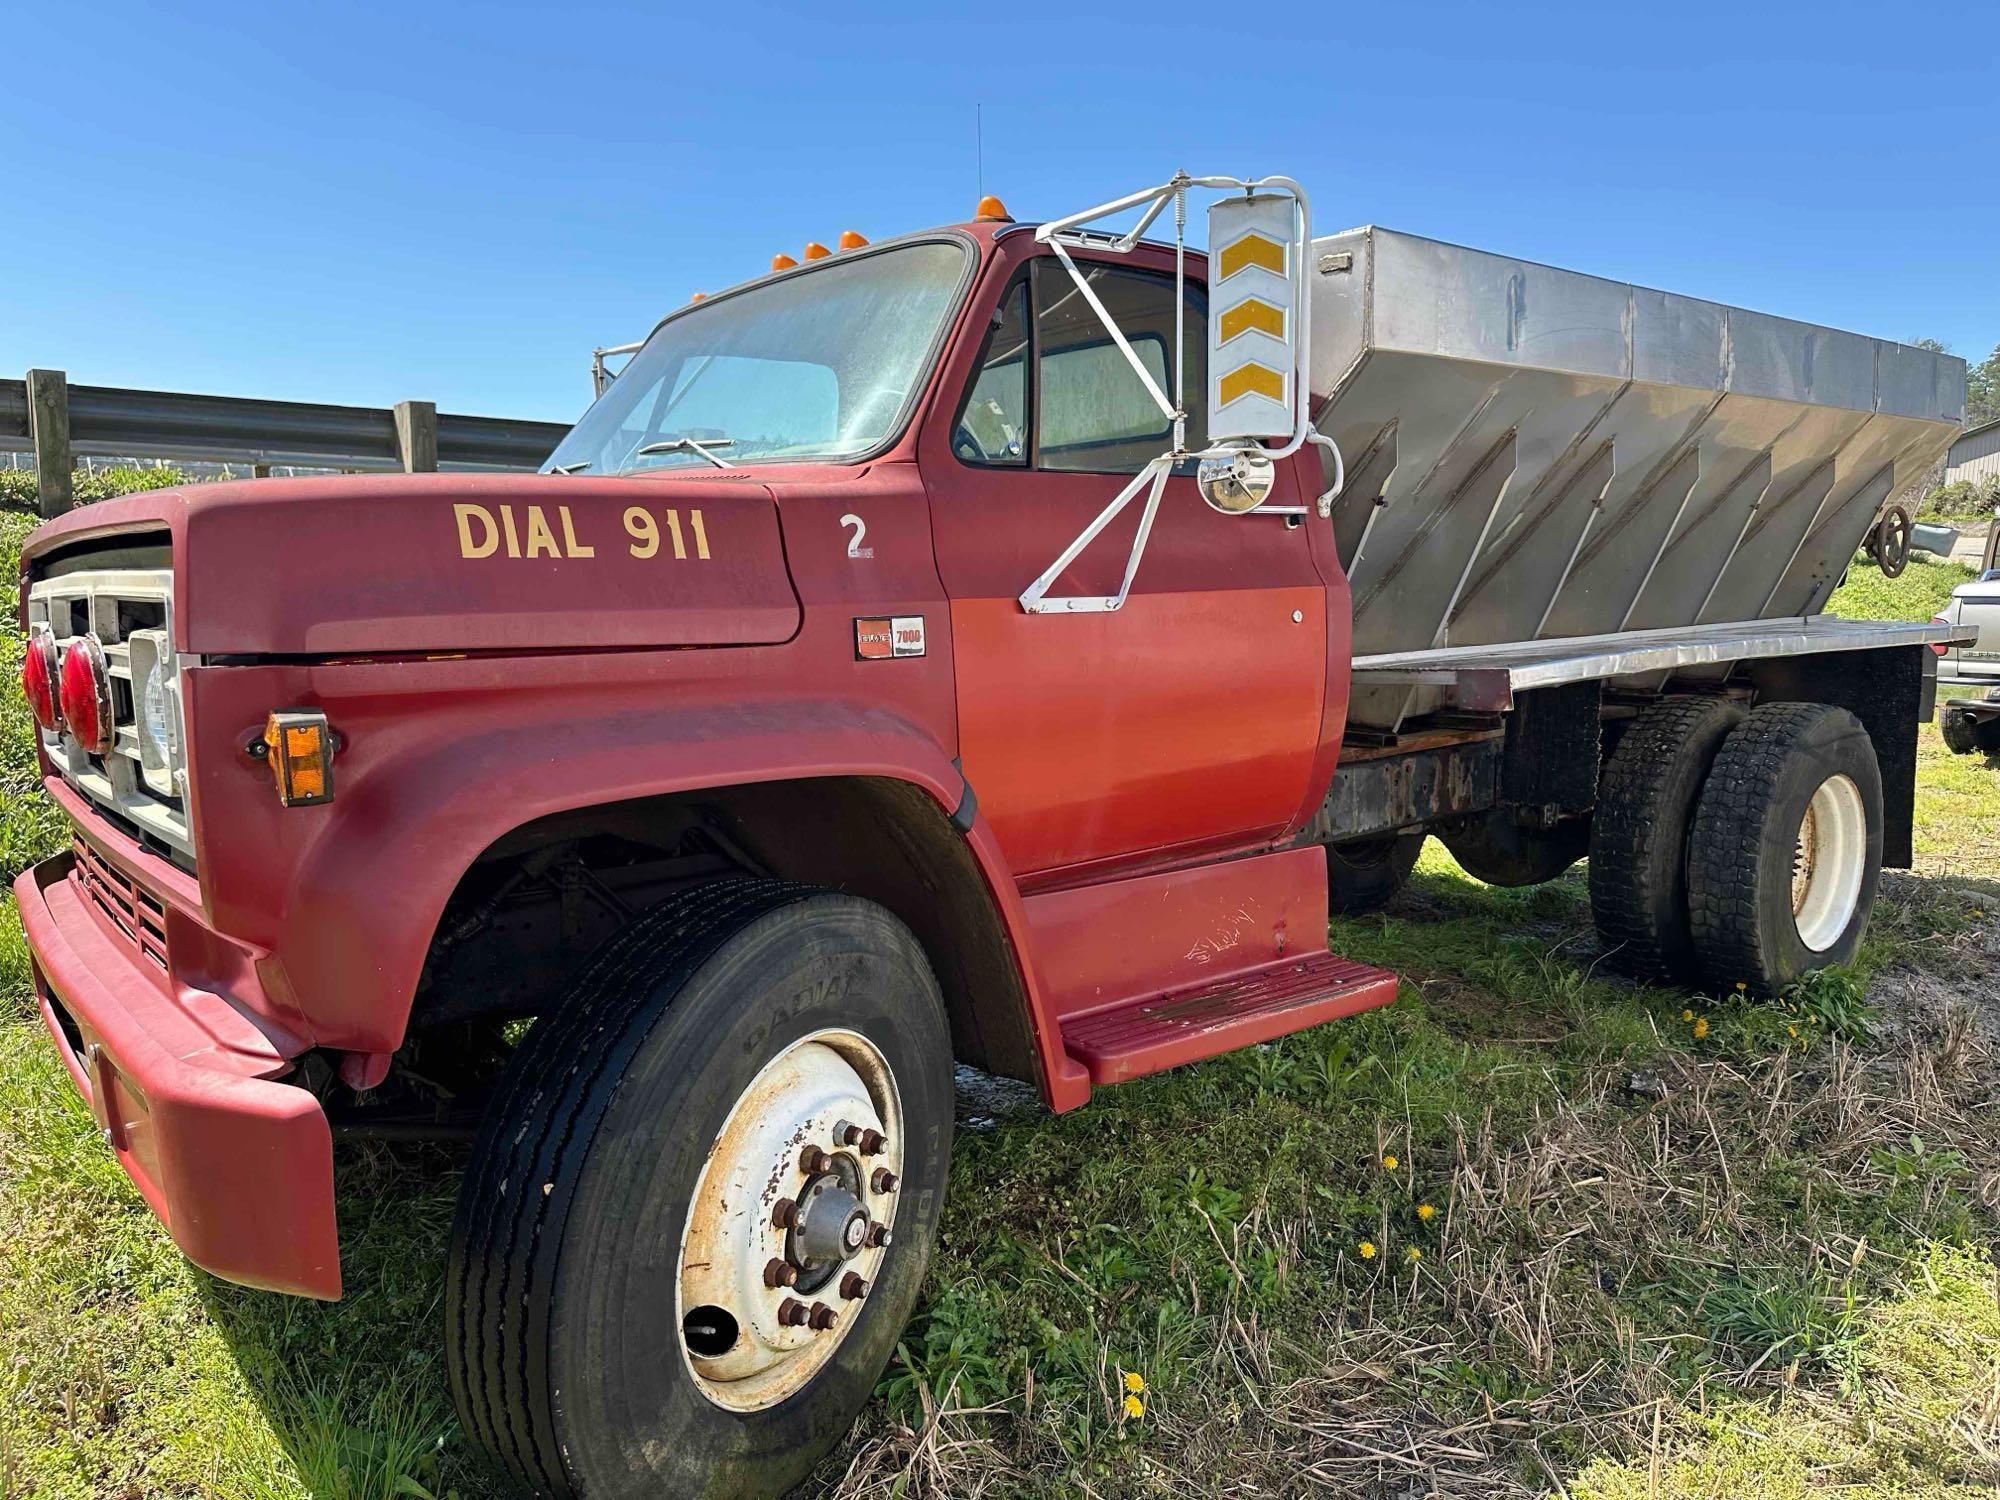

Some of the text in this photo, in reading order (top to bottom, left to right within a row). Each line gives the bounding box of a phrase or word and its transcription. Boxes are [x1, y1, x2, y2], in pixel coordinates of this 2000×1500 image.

[453, 503, 711, 560] DIAL 911
[839, 513, 875, 559] 2
[896, 629, 922, 644] 7000
